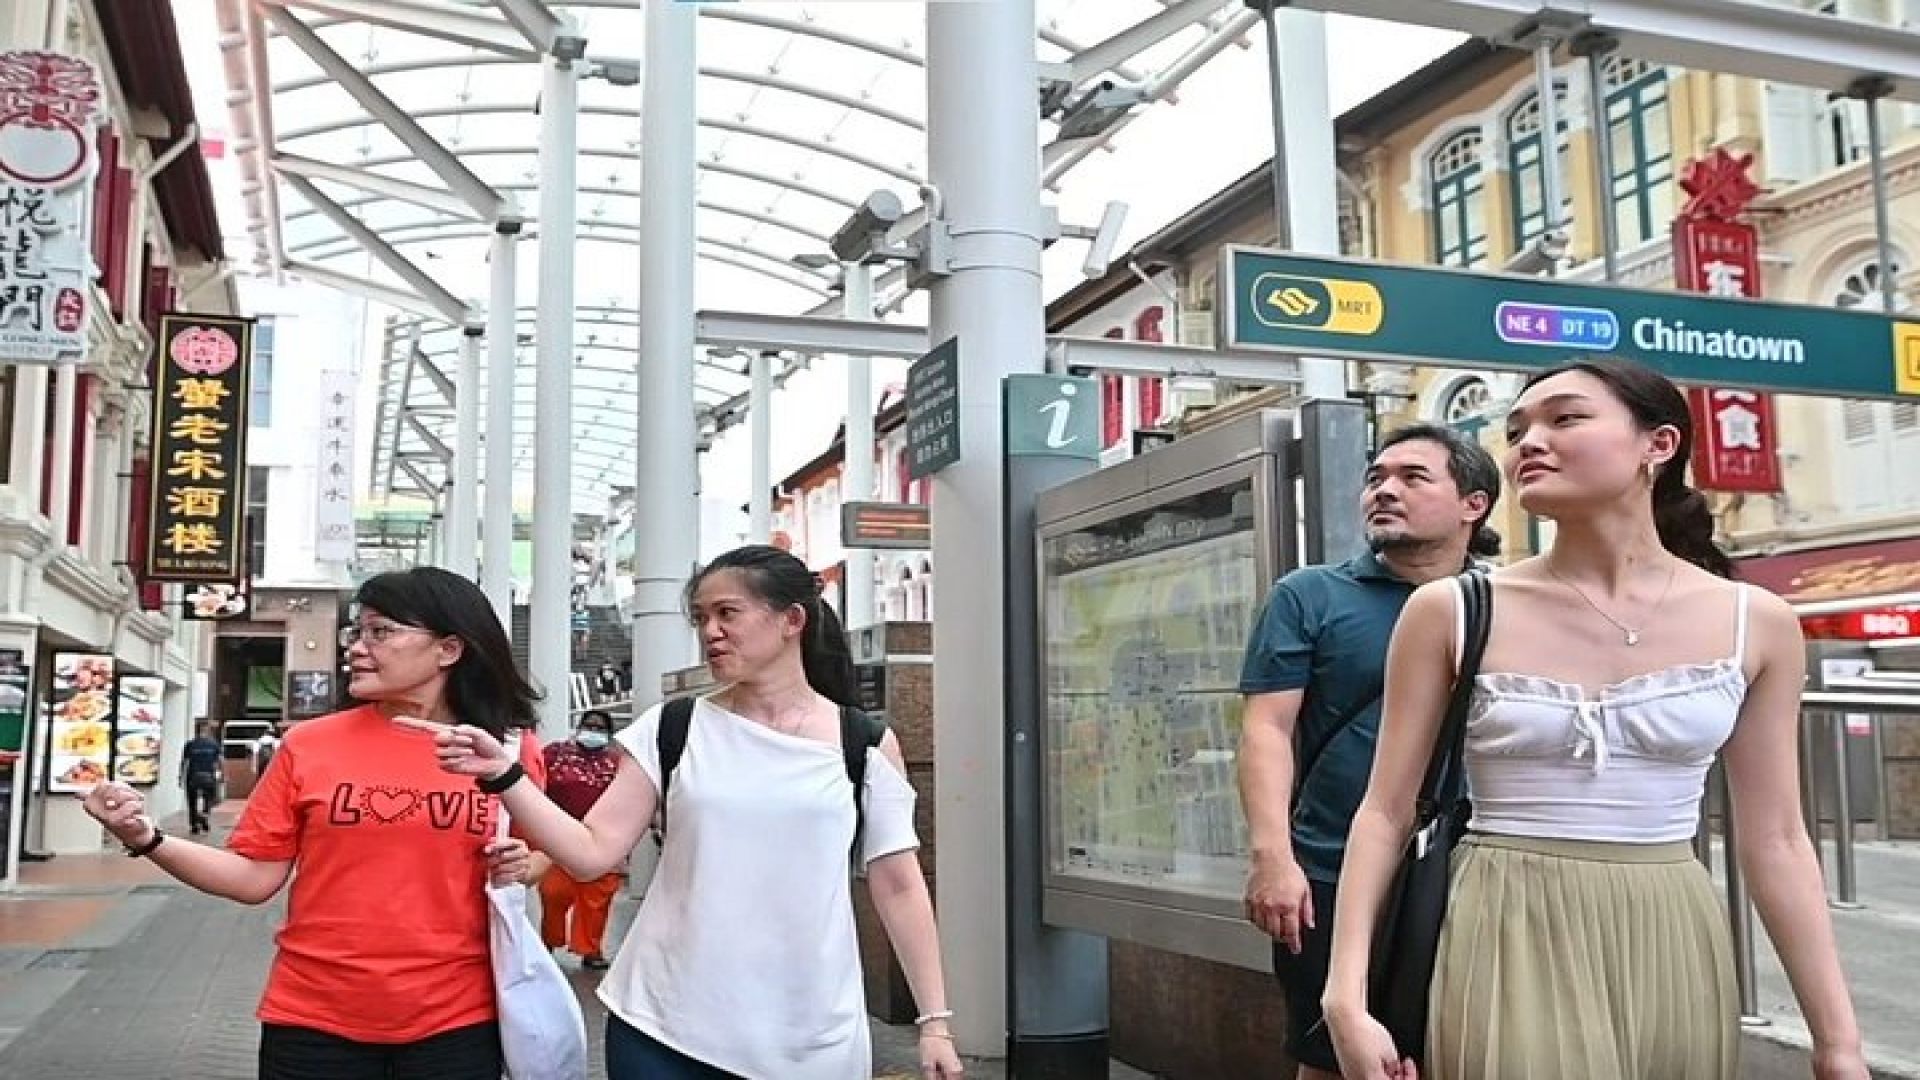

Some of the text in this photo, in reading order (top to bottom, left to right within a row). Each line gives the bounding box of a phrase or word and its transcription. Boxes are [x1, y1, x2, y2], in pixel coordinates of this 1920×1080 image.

[1338, 299, 1372, 315] MRT
[1505, 314, 1806, 364] NE 4 DT 19 Chinatown
